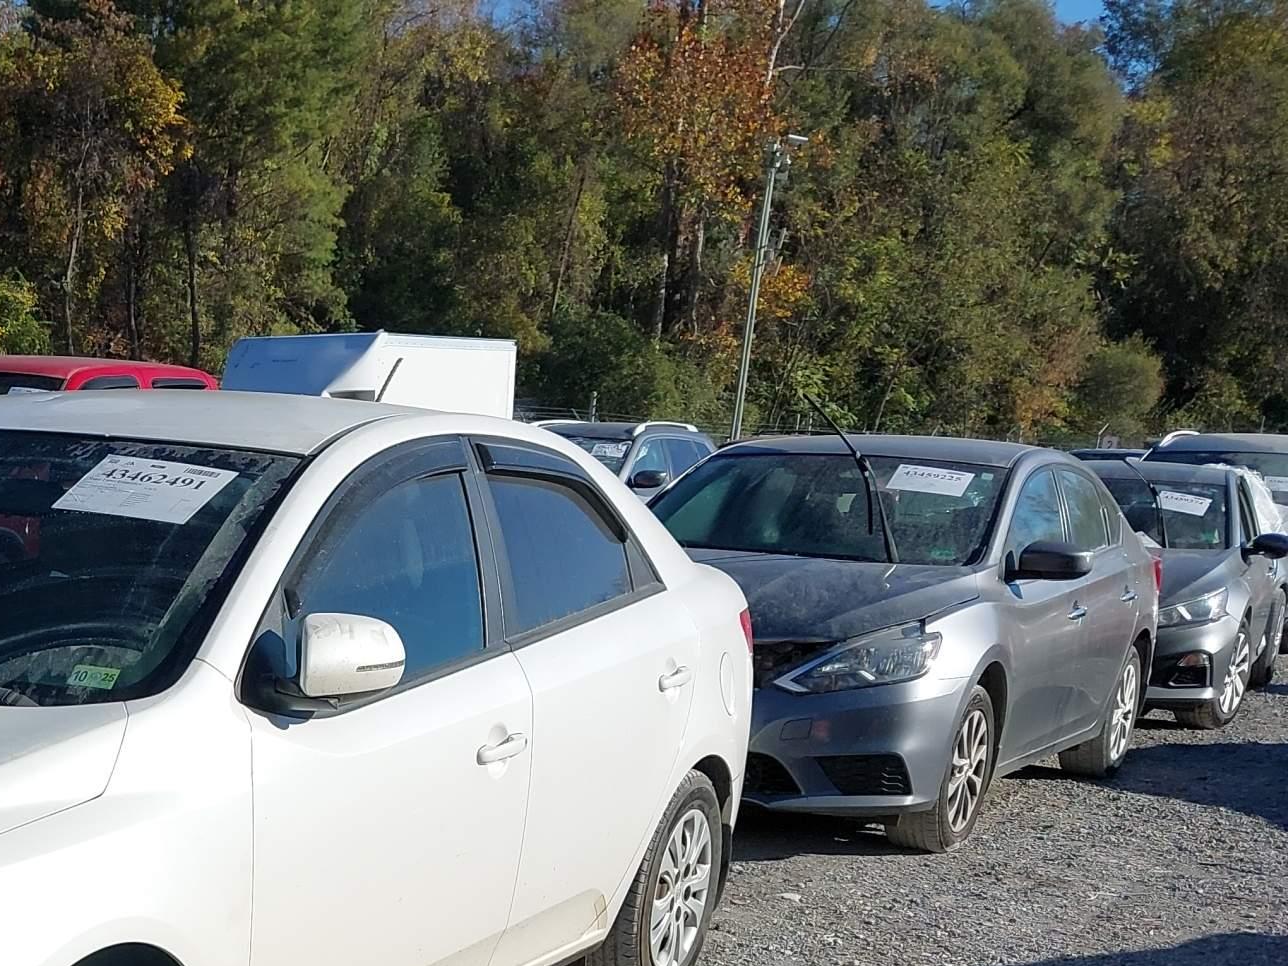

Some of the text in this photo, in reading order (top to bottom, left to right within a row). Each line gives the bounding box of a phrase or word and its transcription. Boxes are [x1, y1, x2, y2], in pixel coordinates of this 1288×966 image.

[102, 468, 206, 490] 43462491
[72, 670, 116, 682] 10 25
